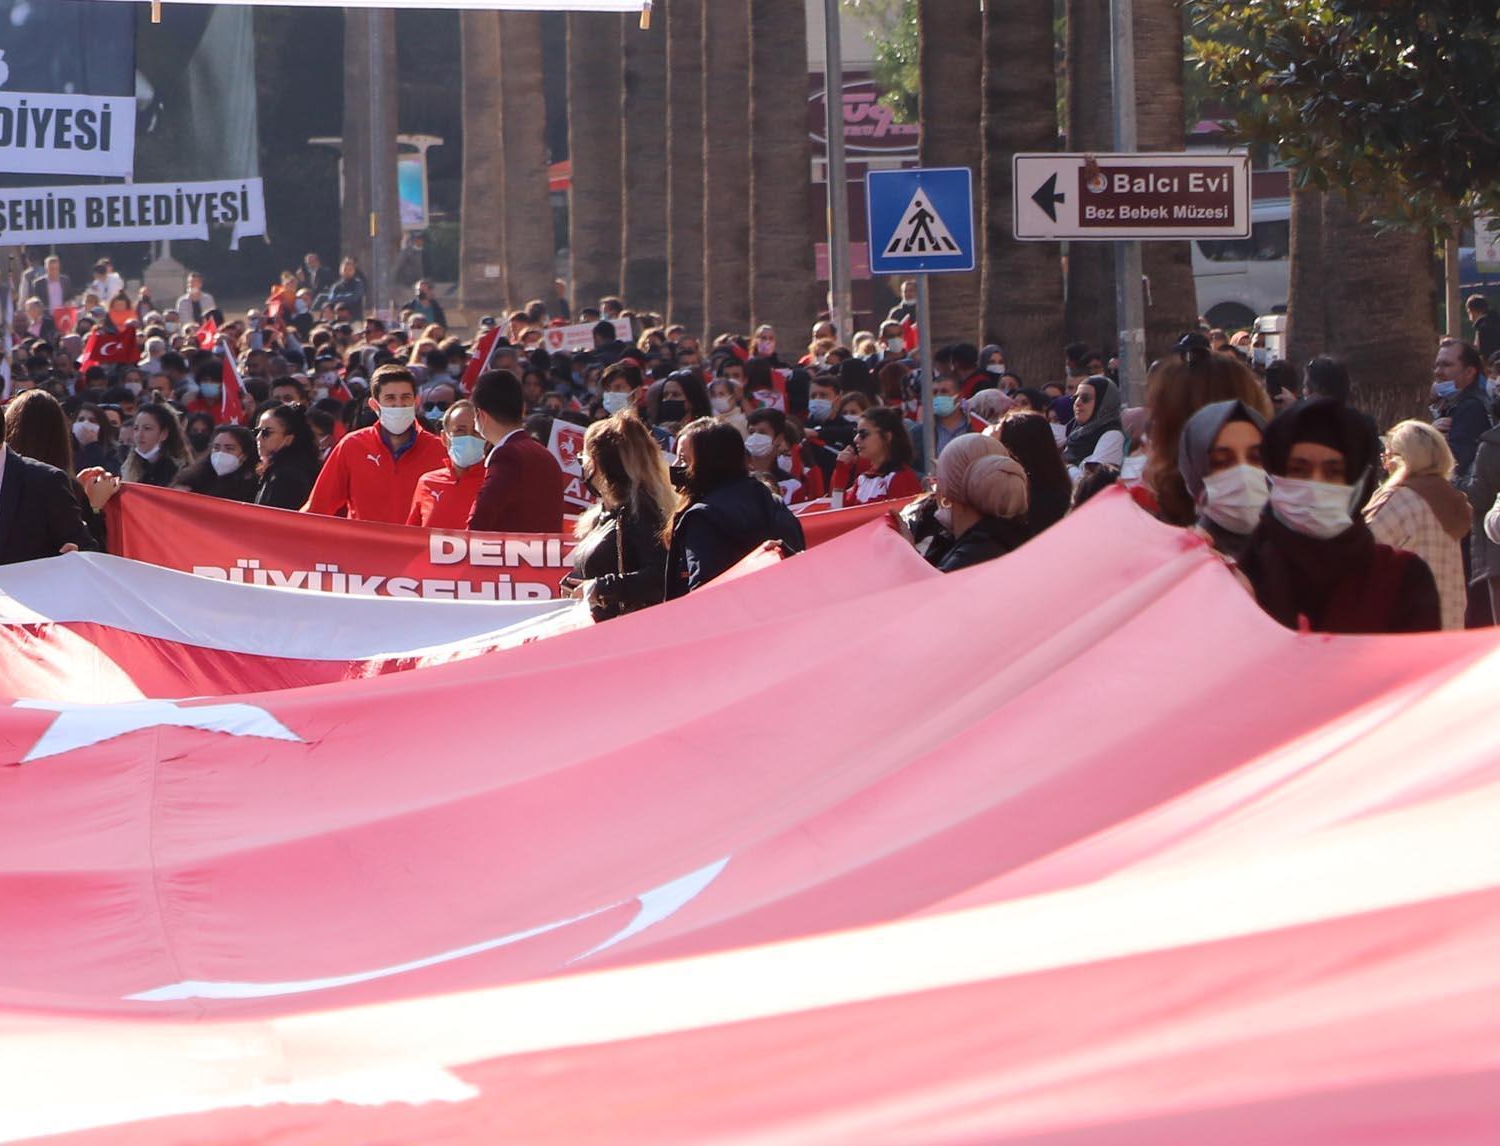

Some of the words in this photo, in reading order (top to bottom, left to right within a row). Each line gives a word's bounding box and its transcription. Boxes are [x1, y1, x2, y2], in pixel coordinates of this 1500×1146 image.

[1113, 173, 1179, 193] Balcı
[1189, 173, 1229, 193] Evi
[85, 184, 249, 229] BELEDİYESİ
[1085, 206, 1115, 219] Bez
[1119, 206, 1169, 219] Bebek
[1173, 205, 1229, 219] Müzesi
